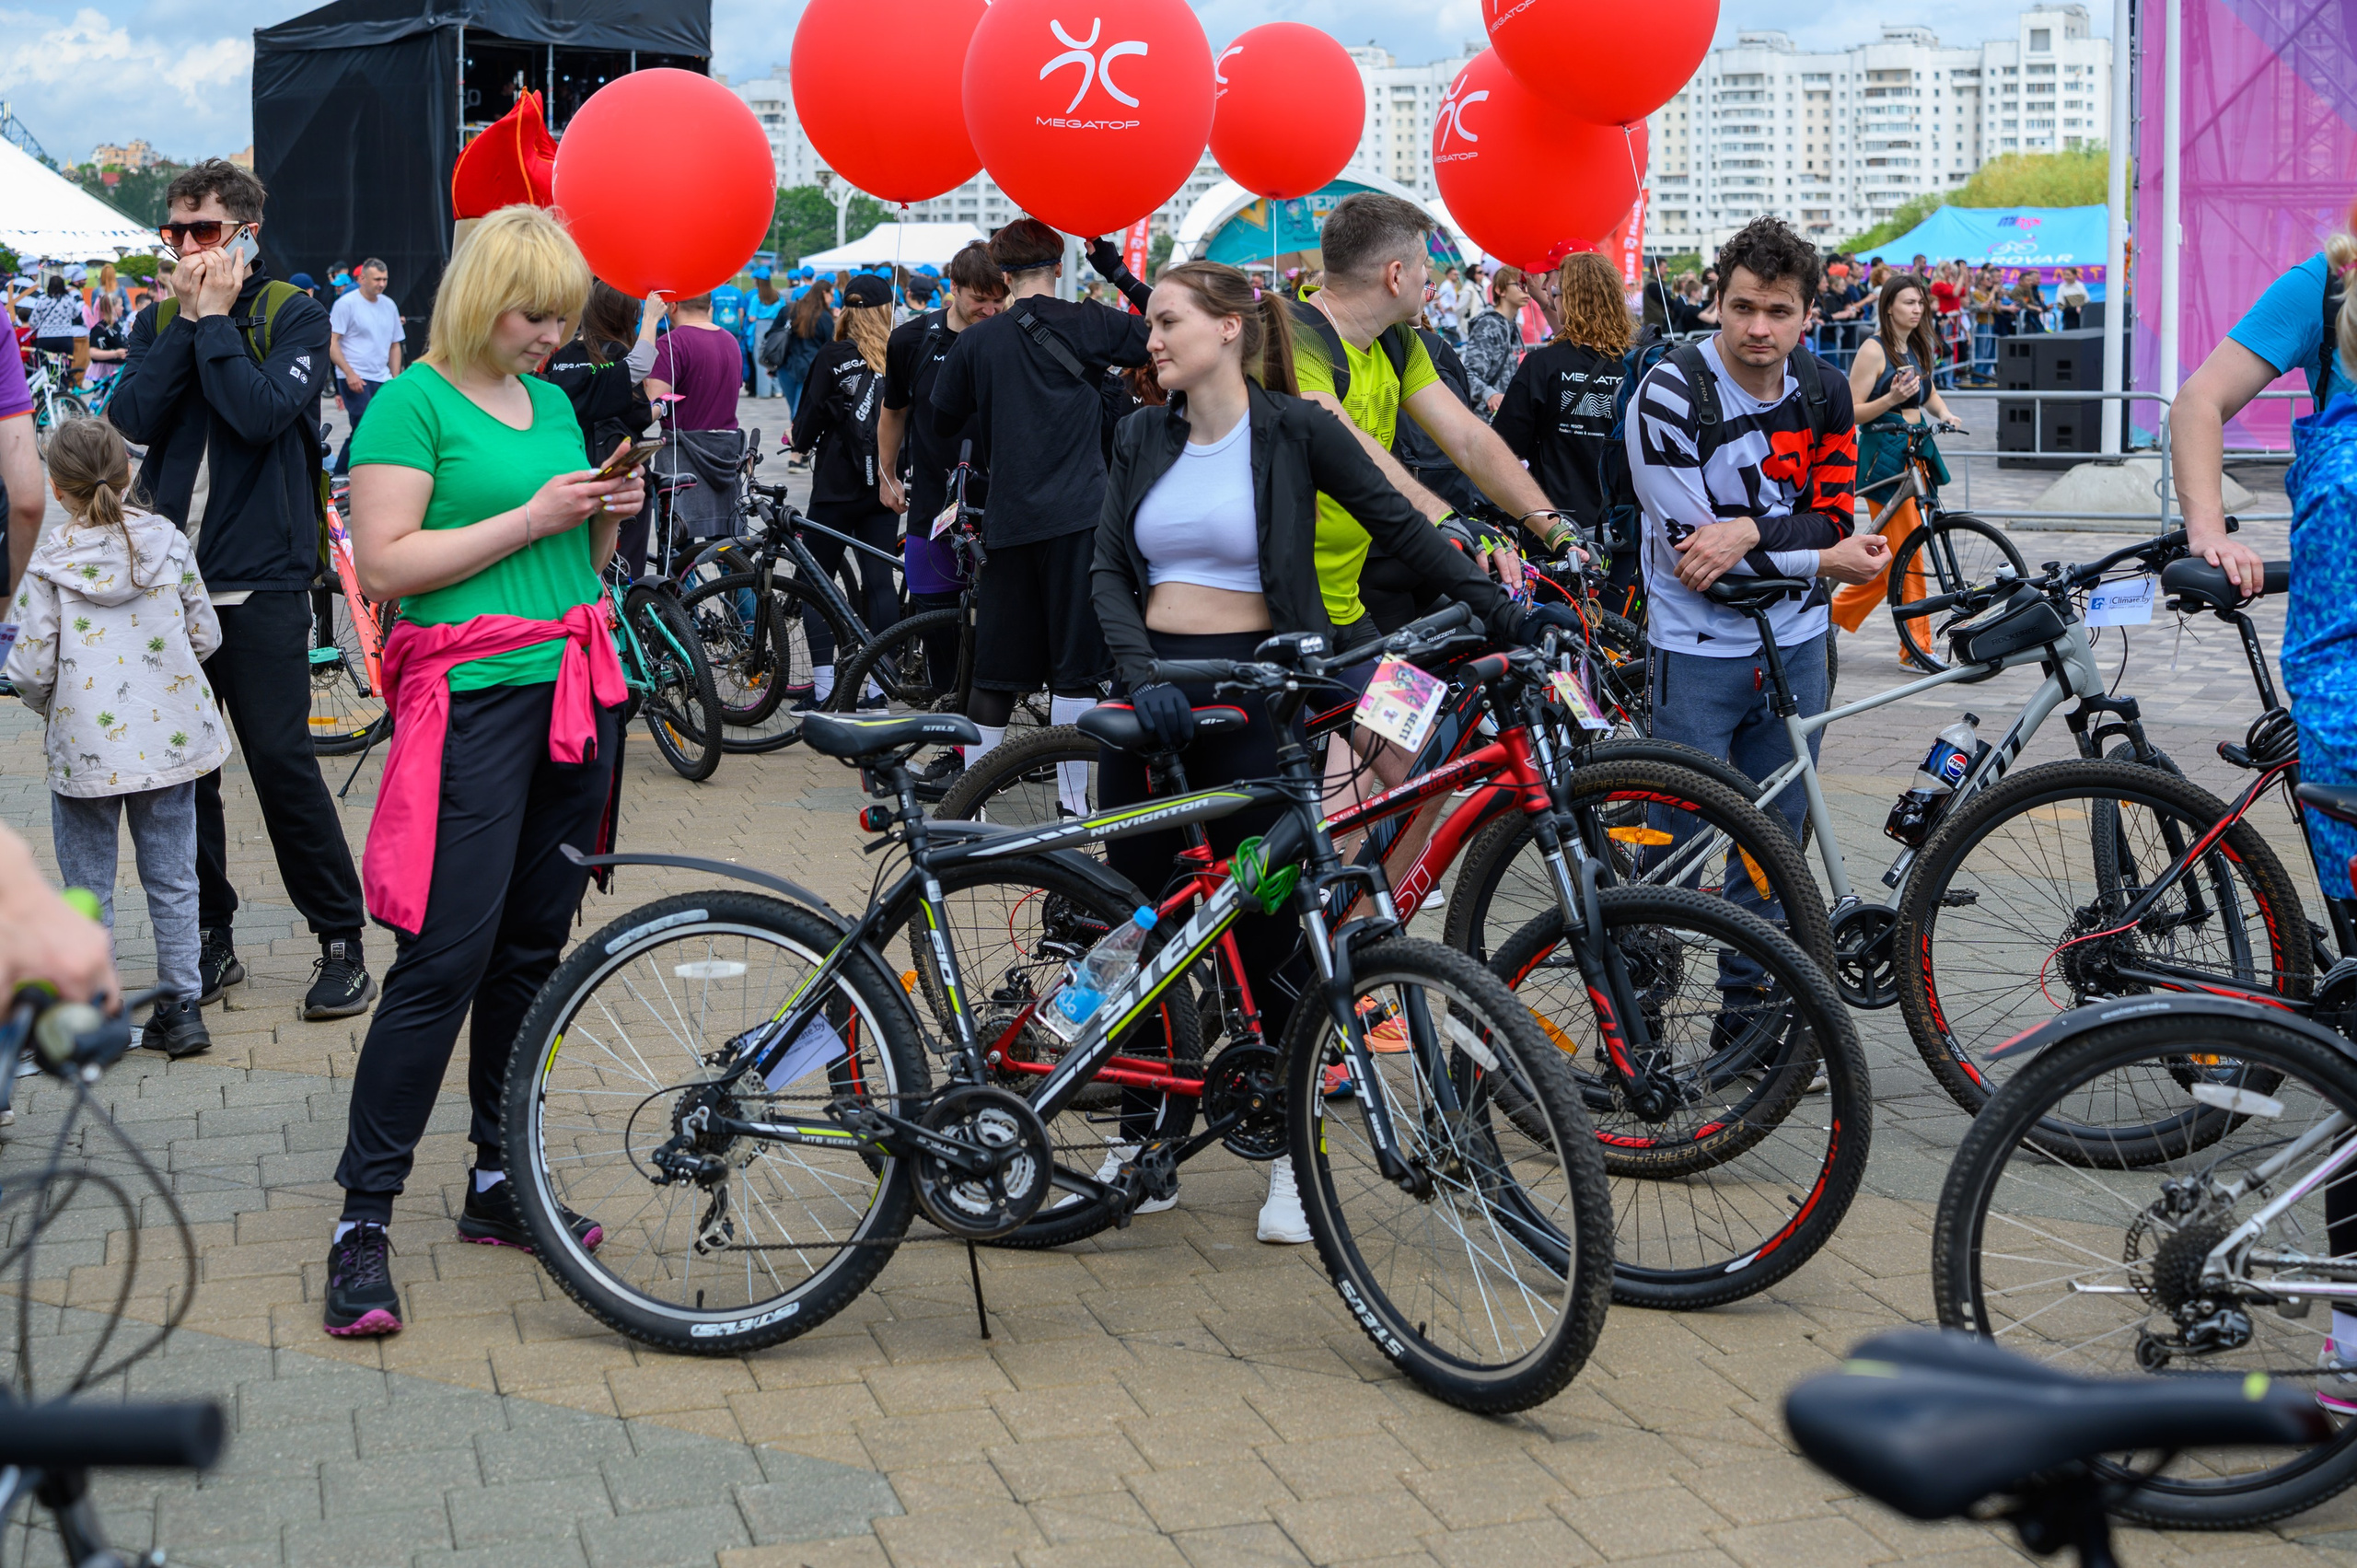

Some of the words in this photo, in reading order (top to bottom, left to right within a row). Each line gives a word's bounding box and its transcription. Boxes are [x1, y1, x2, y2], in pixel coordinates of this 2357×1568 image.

[1036, 115, 1141, 130] MEGATOP
[833, 358, 867, 376] MEGA
[1698, 376, 1709, 401] POLAR
[865, 455, 874, 486] GENERATION
[1991, 624, 2041, 645] ROCKBROS
[2248, 638, 2261, 665] LTD
[922, 725, 958, 733] STELS
[1399, 712, 1419, 741] 11739
[1949, 758, 1965, 772] PEPS
[1419, 770, 1464, 796] QUEST
[1604, 790, 1701, 811] STAGE
[1090, 797, 1210, 837] NAVIGATOR
[1099, 877, 1240, 1035] STELS
[1922, 952, 1950, 1036] STAGE
[801, 1134, 823, 1144] MTB
[827, 1138, 859, 1146] SERIES
[916, 1134, 959, 1156] STELS
[1593, 1129, 1660, 1148] AGE
[1657, 1146, 1698, 1163] GEAR
[1338, 1279, 1405, 1357] STELS
